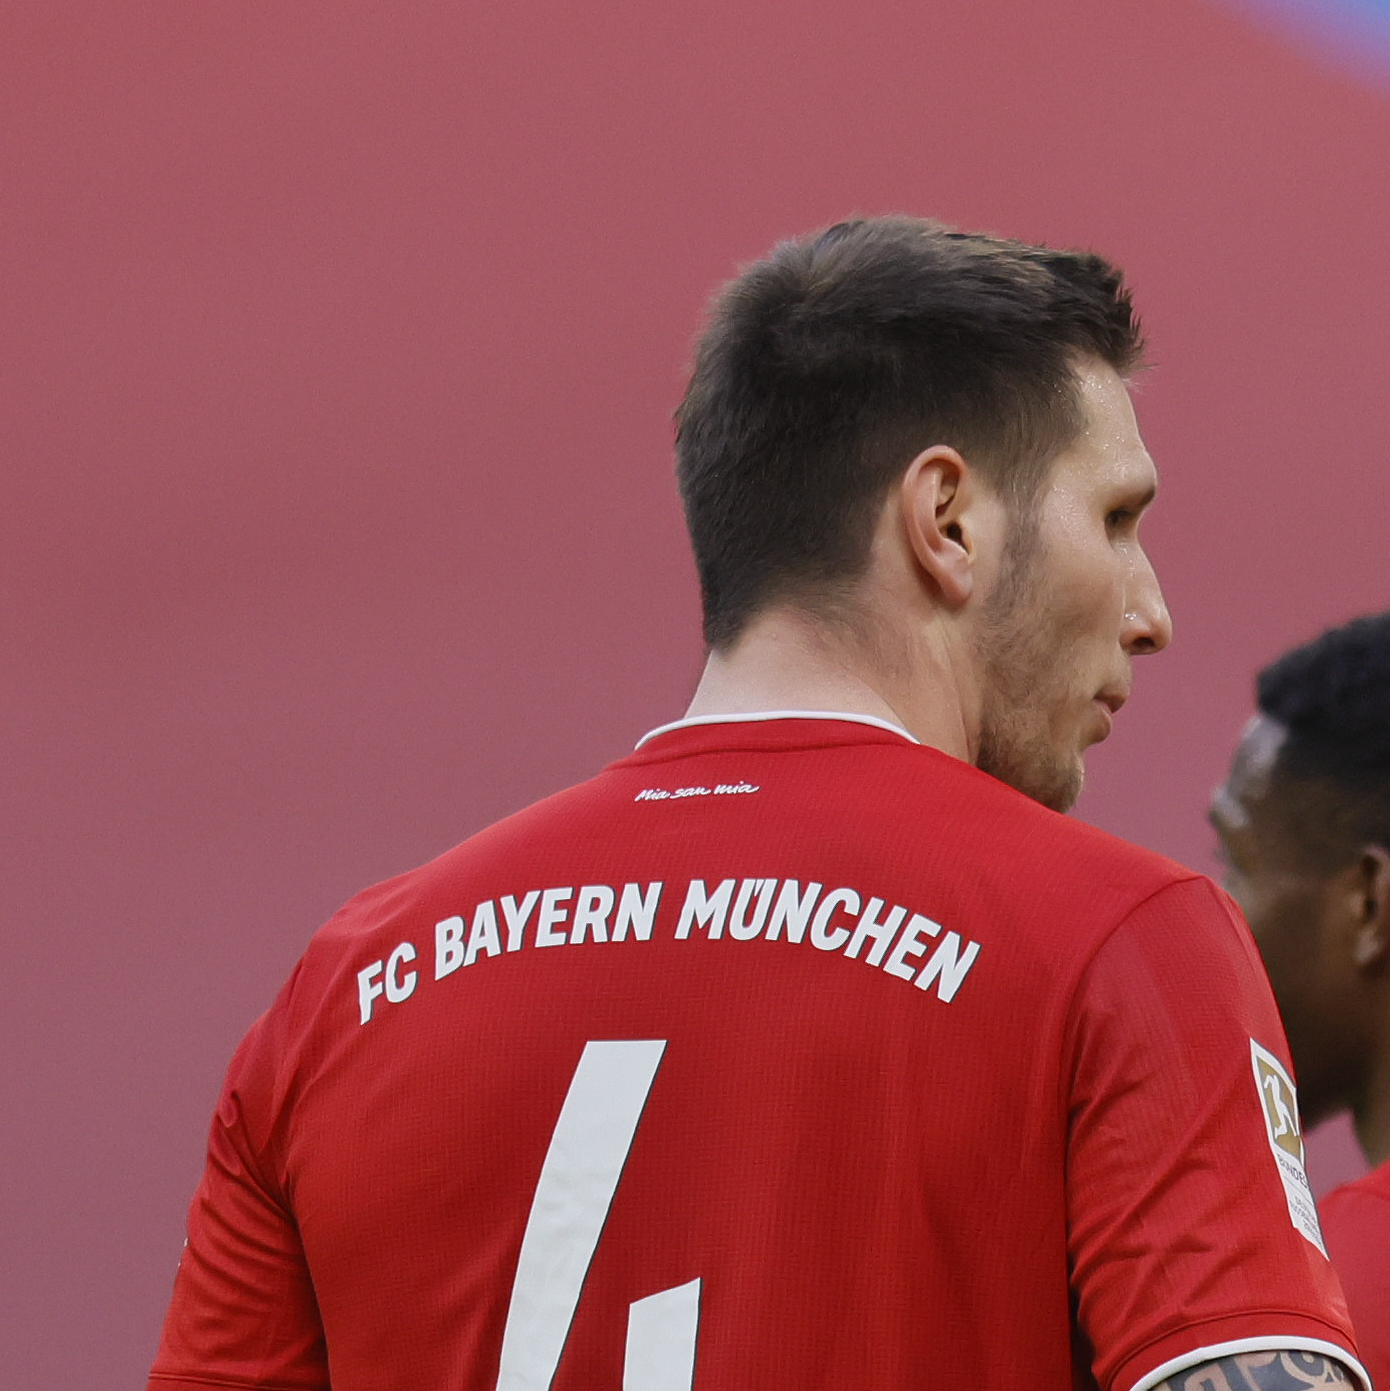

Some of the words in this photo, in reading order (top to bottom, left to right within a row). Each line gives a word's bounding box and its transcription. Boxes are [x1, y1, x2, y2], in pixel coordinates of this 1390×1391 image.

[357, 941, 417, 1026] FC
[434, 881, 663, 981] BAYERN
[673, 878, 981, 1004] MÜNCHEN
